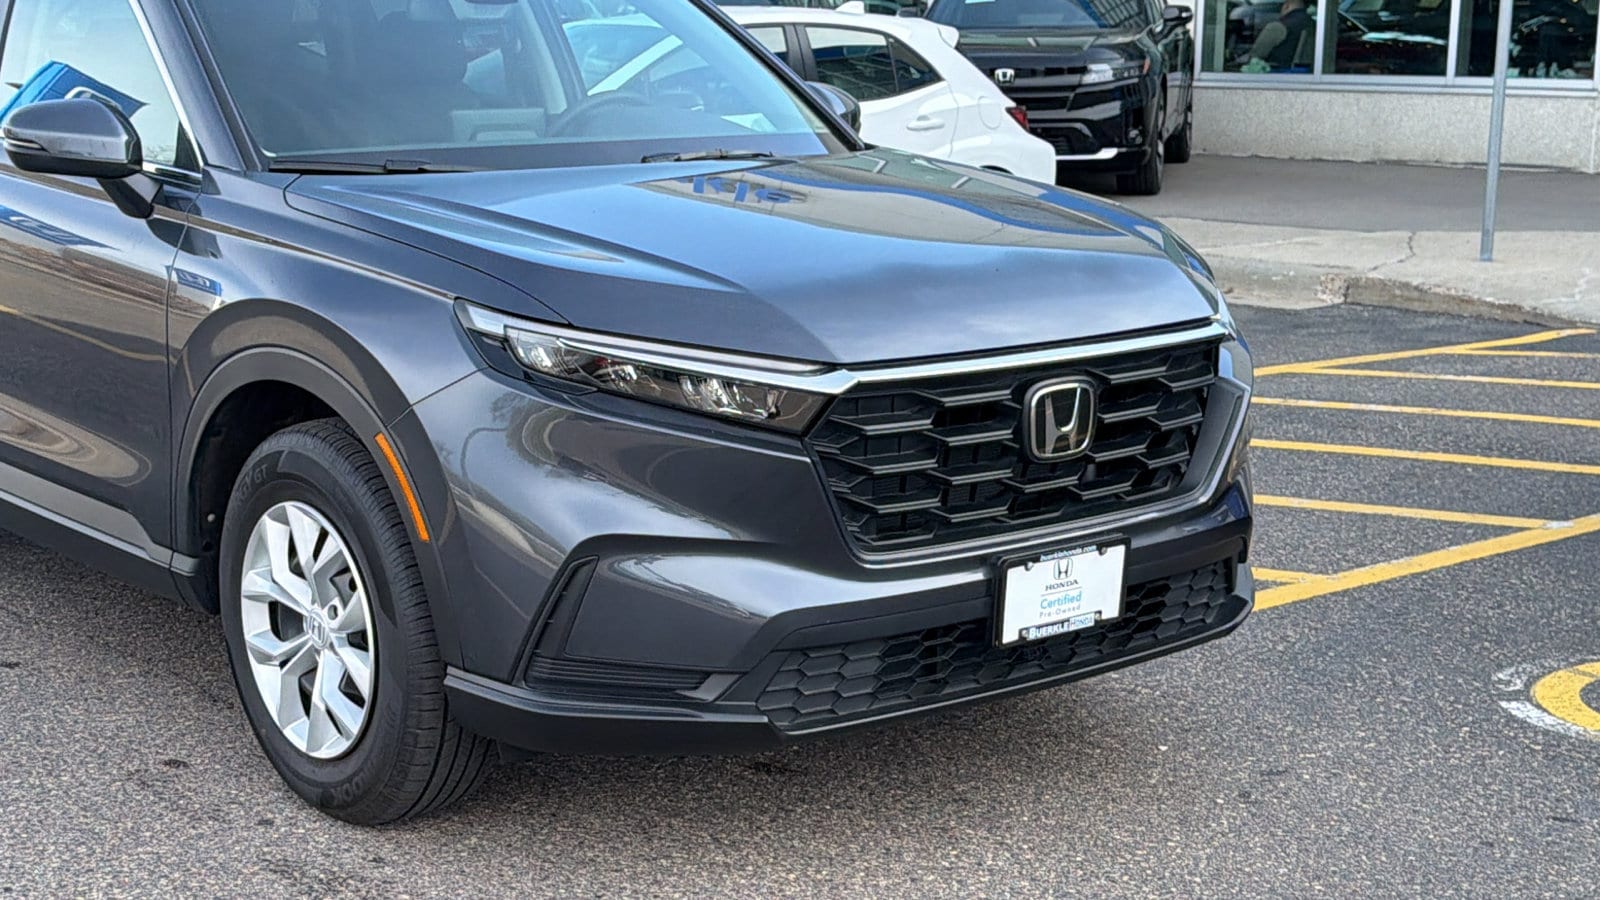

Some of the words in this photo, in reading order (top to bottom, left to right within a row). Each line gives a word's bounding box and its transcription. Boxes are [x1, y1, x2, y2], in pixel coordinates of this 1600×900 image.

[1045, 579, 1079, 592] HONDA
[1040, 591, 1082, 609] Certified
[1039, 604, 1081, 618] Pre-Owned
